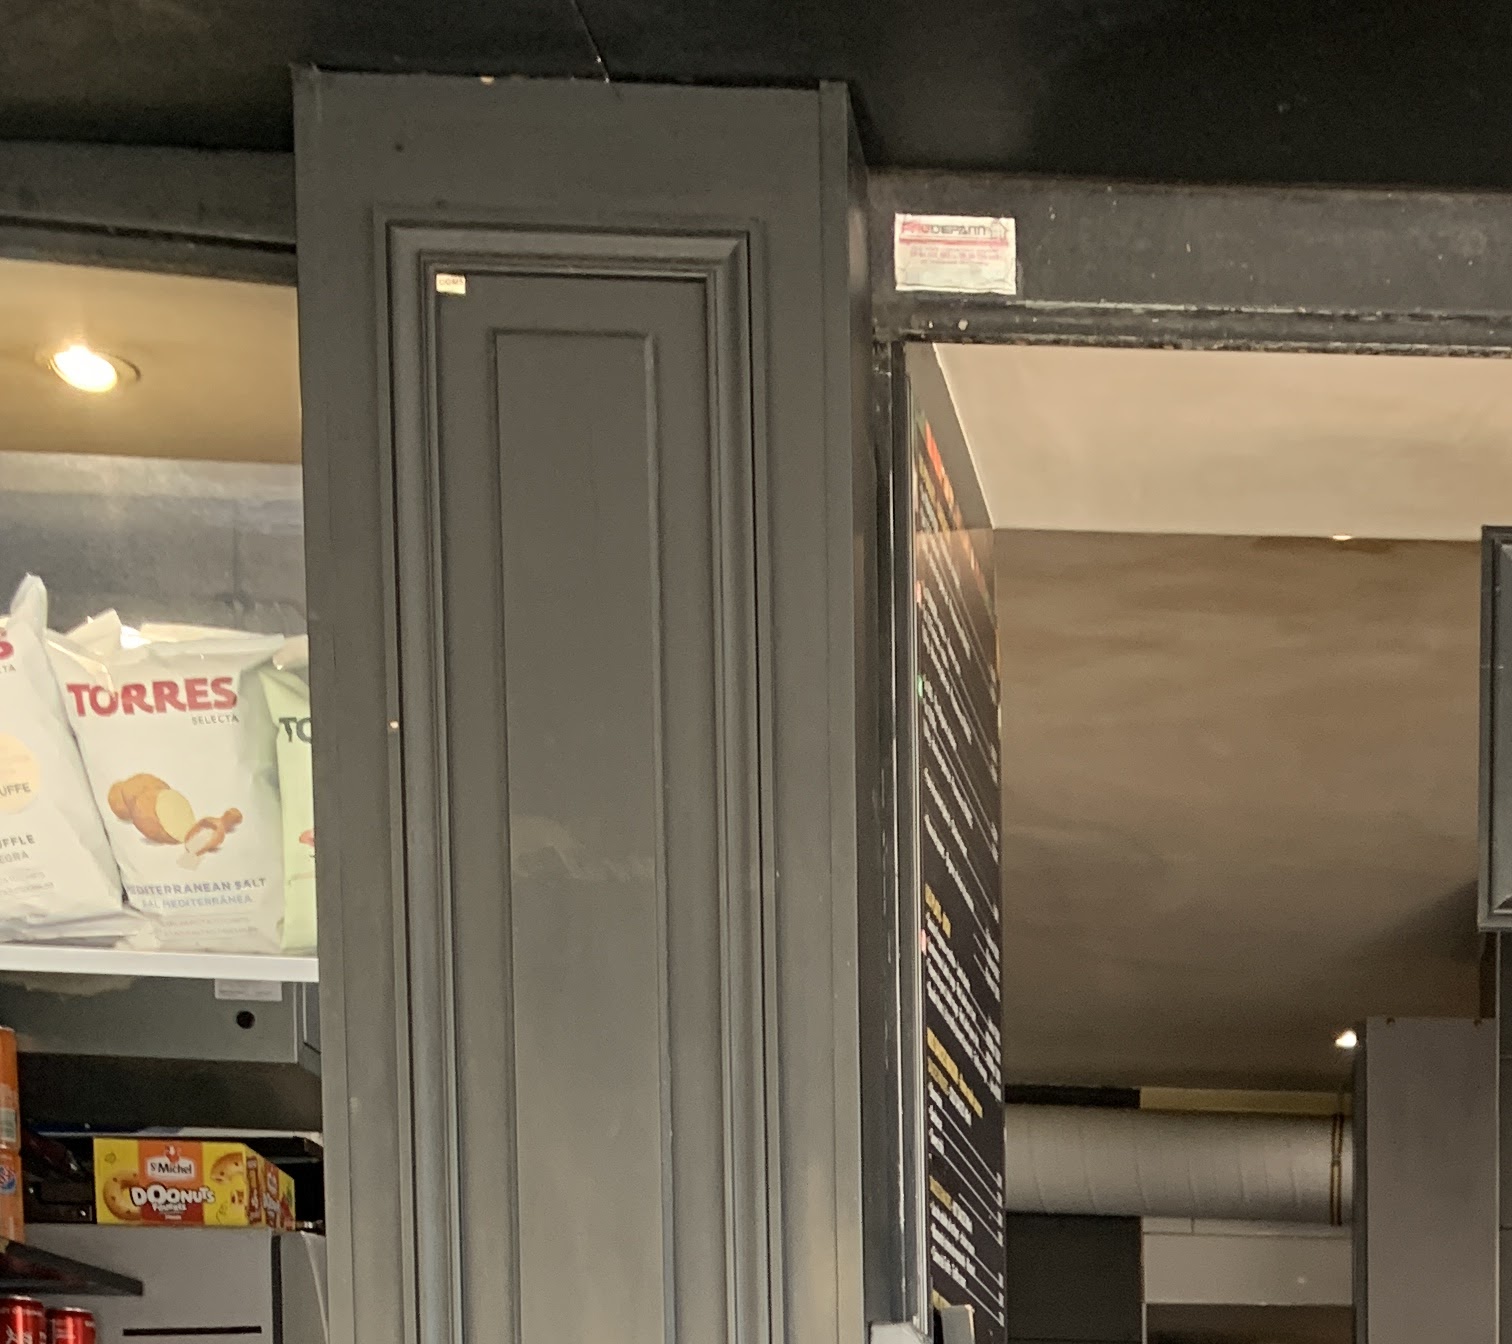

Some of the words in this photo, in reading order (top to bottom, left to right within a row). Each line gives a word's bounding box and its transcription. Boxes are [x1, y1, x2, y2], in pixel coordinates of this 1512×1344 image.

[66, 676, 238, 718] TORRES
[191, 713, 240, 726] SELECTA
[234, 876, 267, 890] SALT
[158, 1161, 193, 1174] Michel
[130, 1183, 216, 1206] DOONUTS
